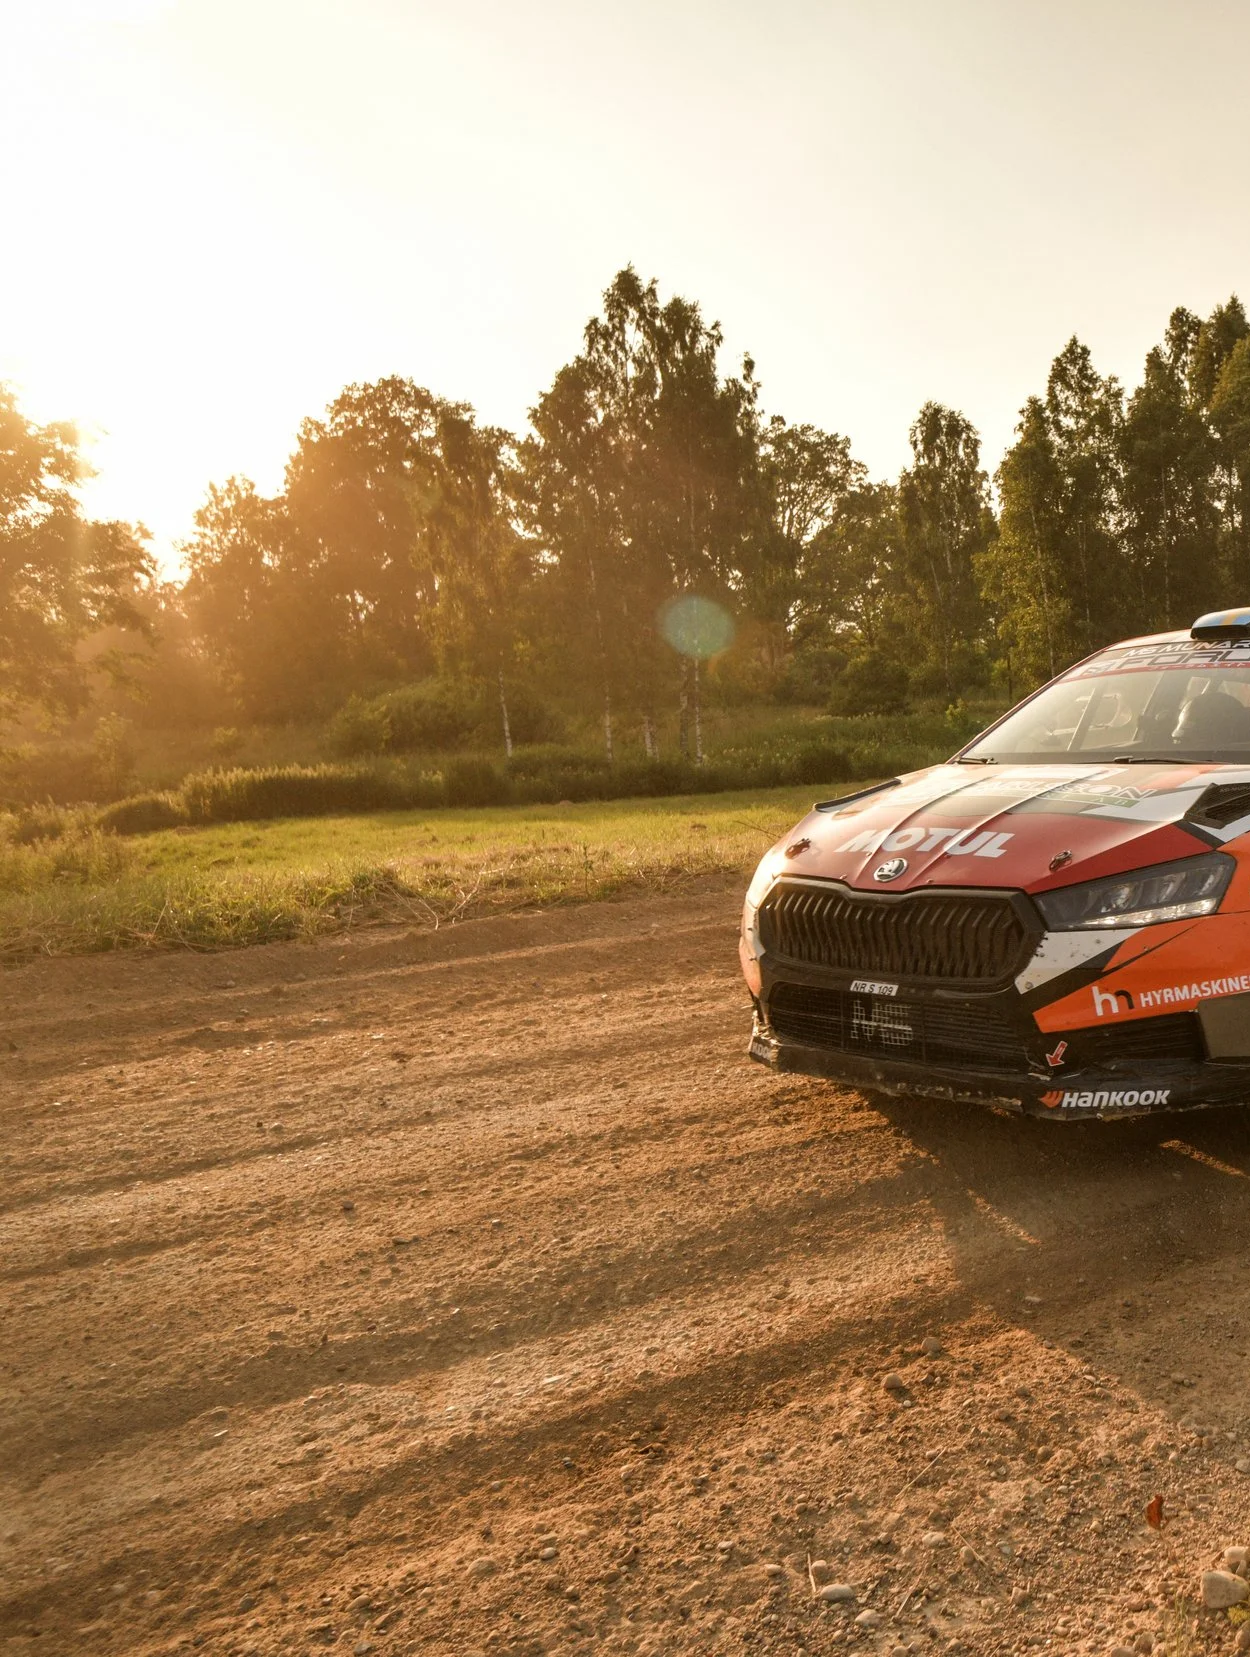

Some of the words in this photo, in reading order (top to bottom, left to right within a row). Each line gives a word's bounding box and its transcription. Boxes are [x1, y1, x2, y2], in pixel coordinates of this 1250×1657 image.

[833, 827, 1015, 858] MOTUL
[852, 982, 867, 993] NR
[868, 983, 876, 994] S
[878, 985, 894, 996] 109
